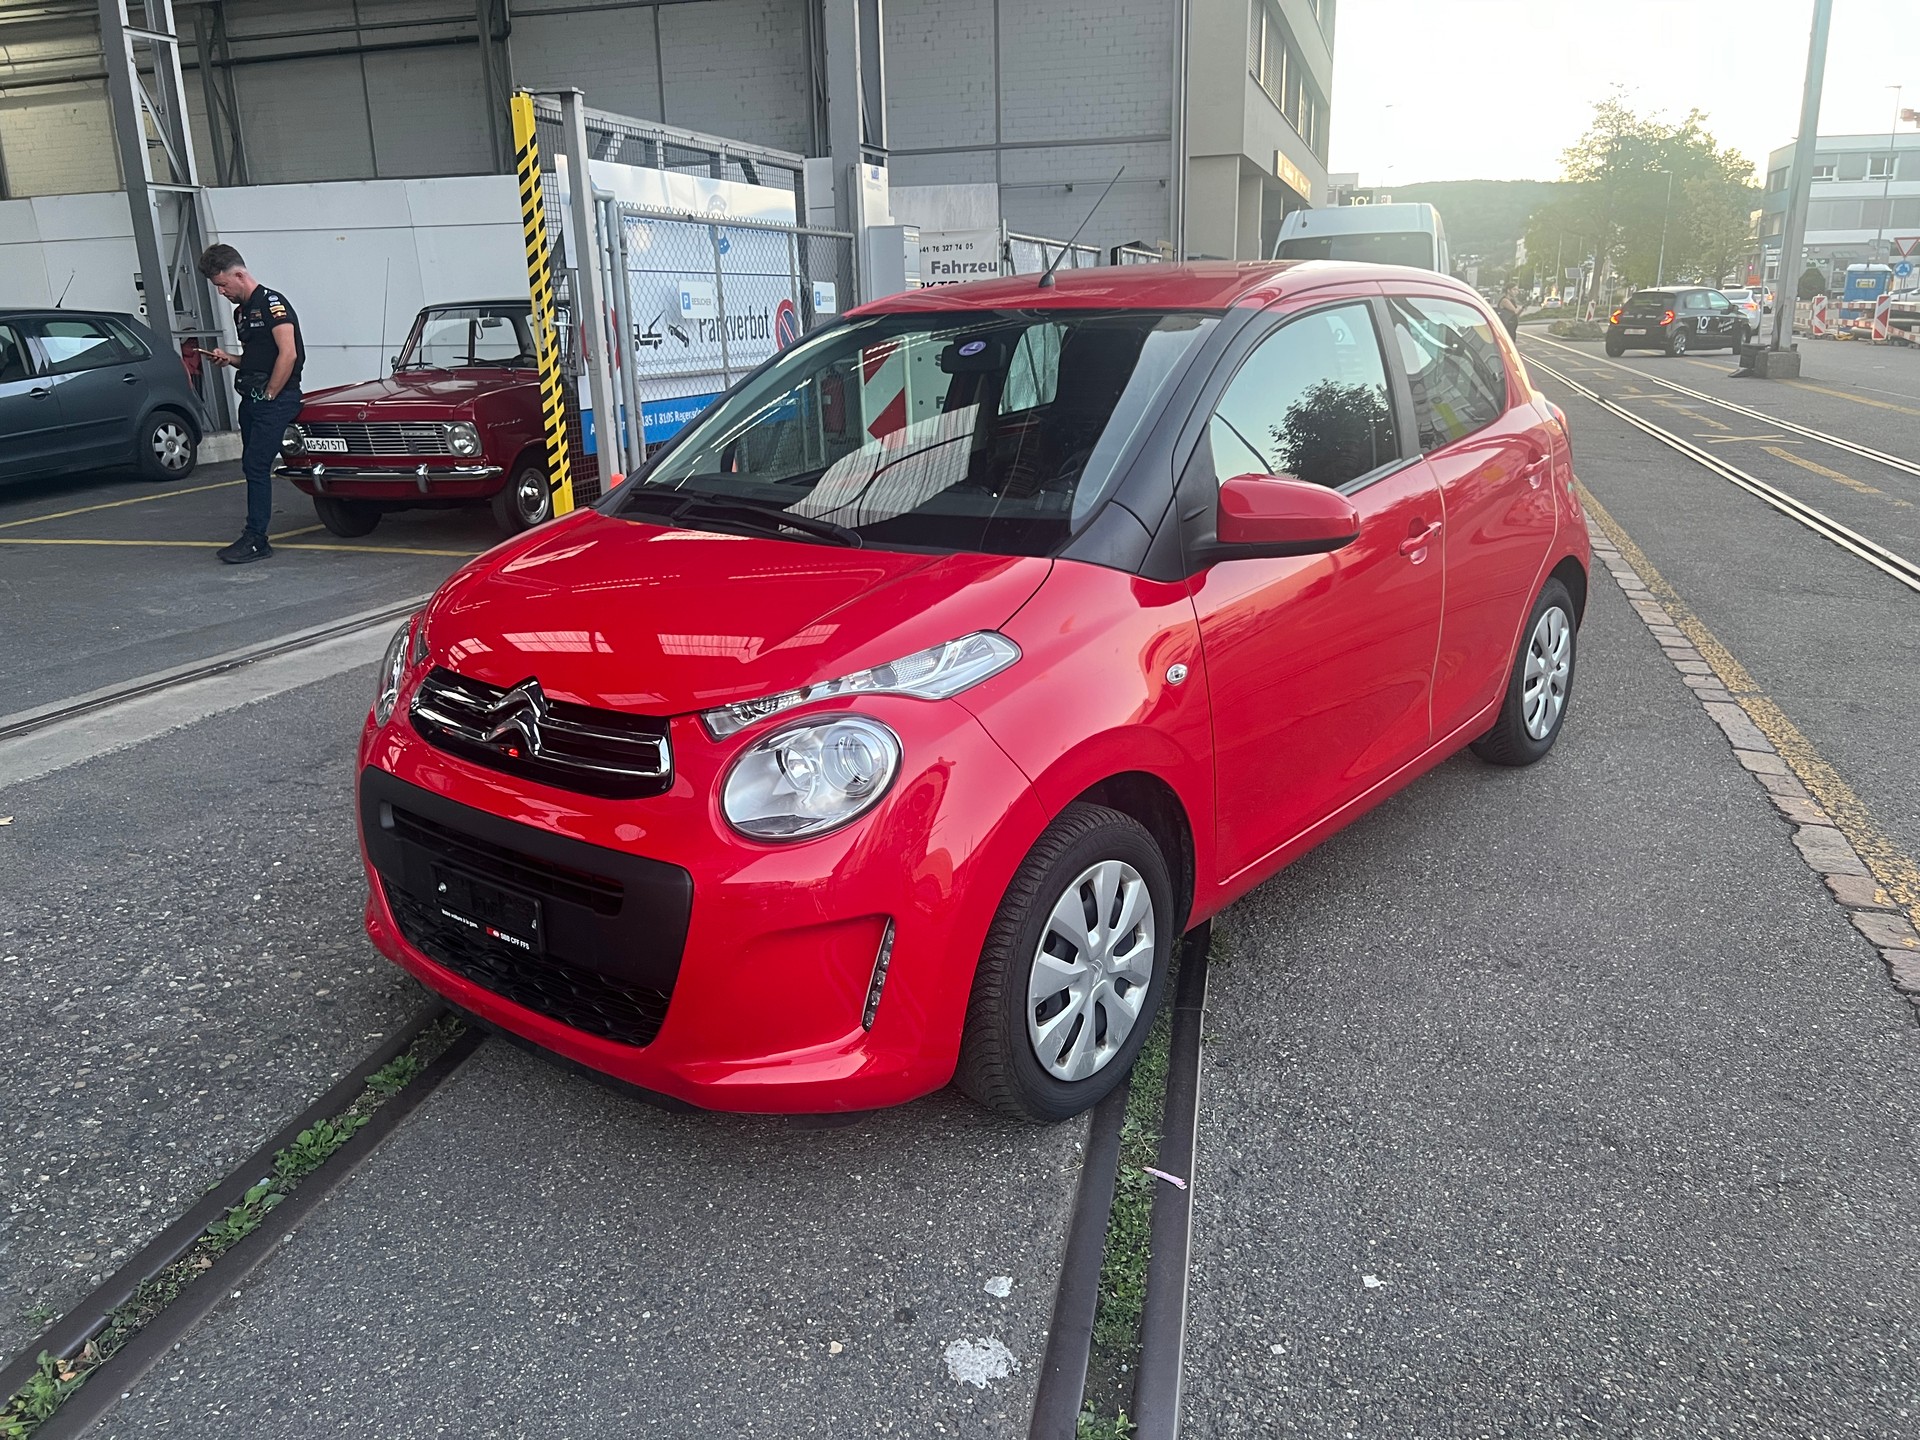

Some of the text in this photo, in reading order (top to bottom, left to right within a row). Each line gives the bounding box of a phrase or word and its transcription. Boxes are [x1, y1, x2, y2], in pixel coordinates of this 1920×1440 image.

[932, 245, 940, 253] 76
[942, 244, 953, 252] 327
[955, 243, 962, 251] 74
[965, 242, 974, 250] 05
